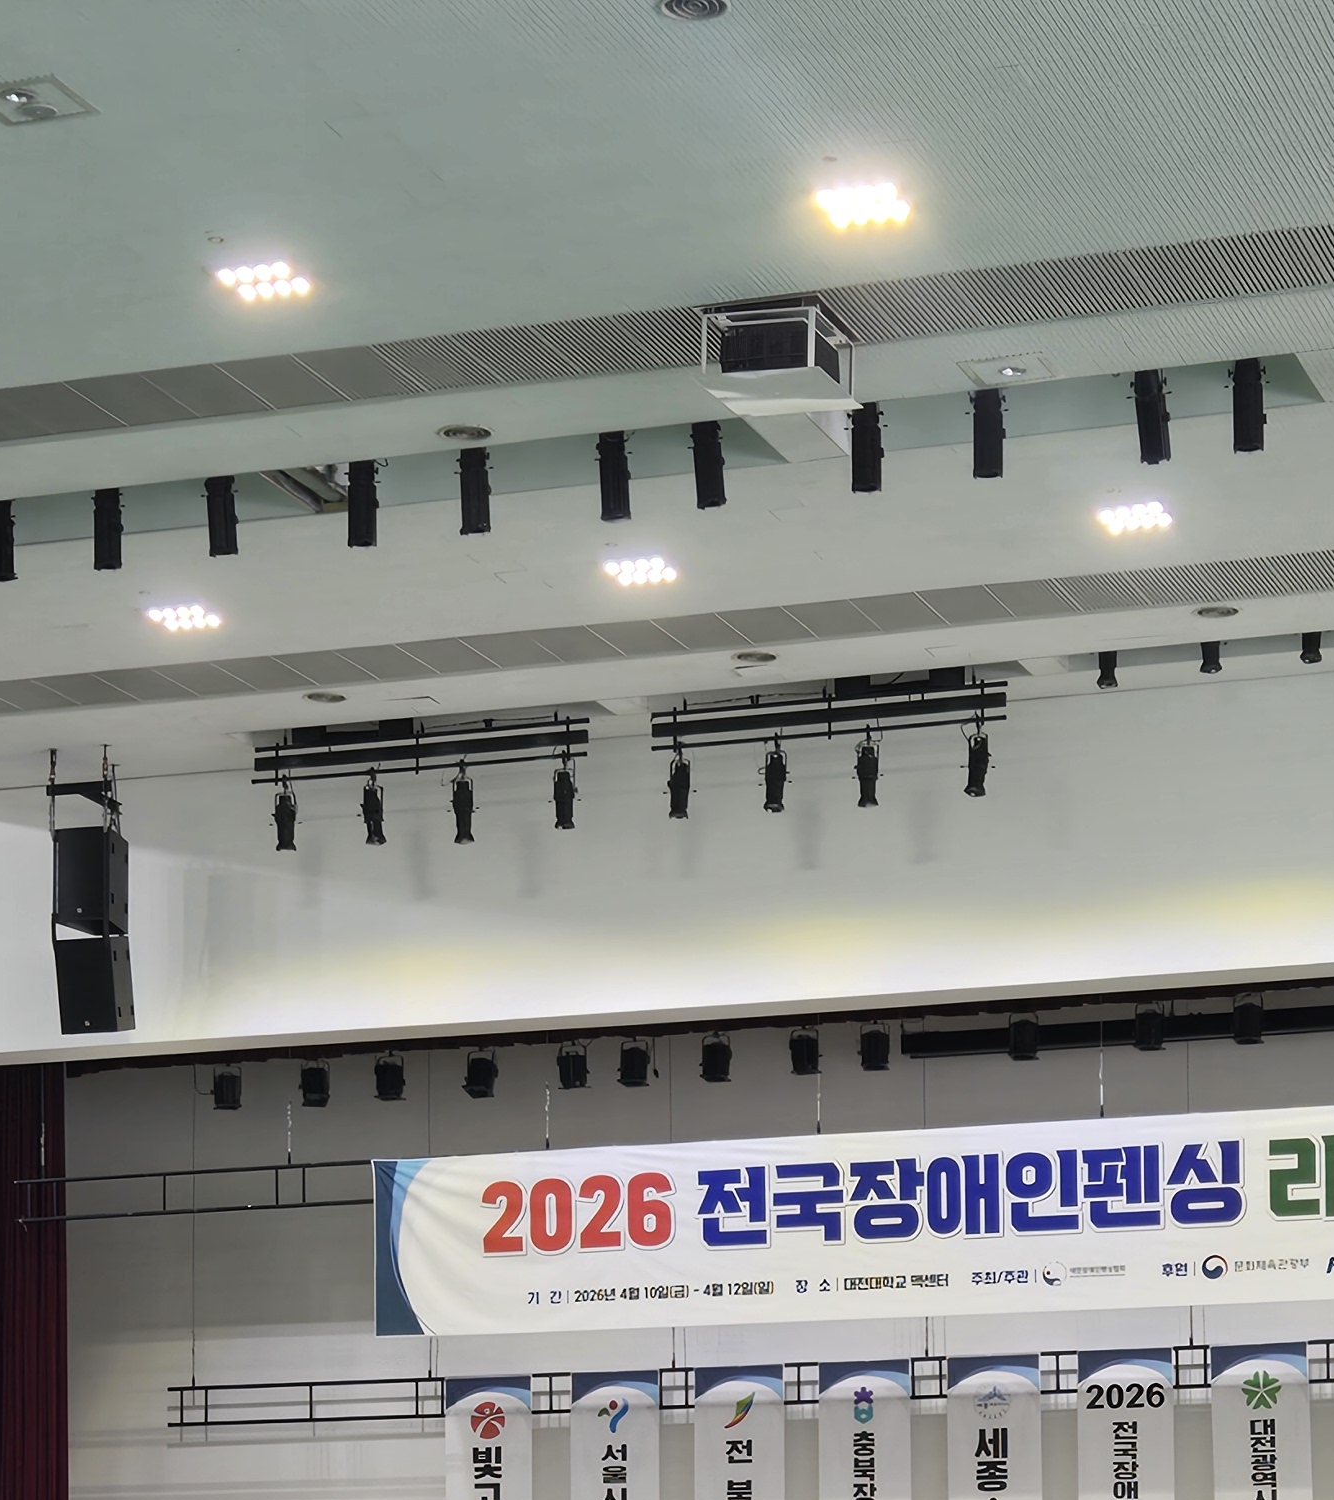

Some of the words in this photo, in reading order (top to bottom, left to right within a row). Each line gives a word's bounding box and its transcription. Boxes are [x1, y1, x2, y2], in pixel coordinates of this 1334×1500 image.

[480, 1171, 676, 1257] 2026
[695, 1138, 1247, 1251] 전국장애인펜싱
[971, 1269, 1030, 1287] 주최/주관
[1161, 1262, 1189, 1278] 후원
[574, 1288, 616, 1303] 2026년
[619, 1286, 640, 1301] 4월
[643, 1284, 690, 1300] 10일(금)
[703, 1283, 724, 1298] 4월
[727, 1280, 774, 1296] 12일(일)
[843, 1274, 907, 1291] 대전대학교
[1085, 1382, 1166, 1410] 2026
[975, 1427, 1010, 1493] 세종
